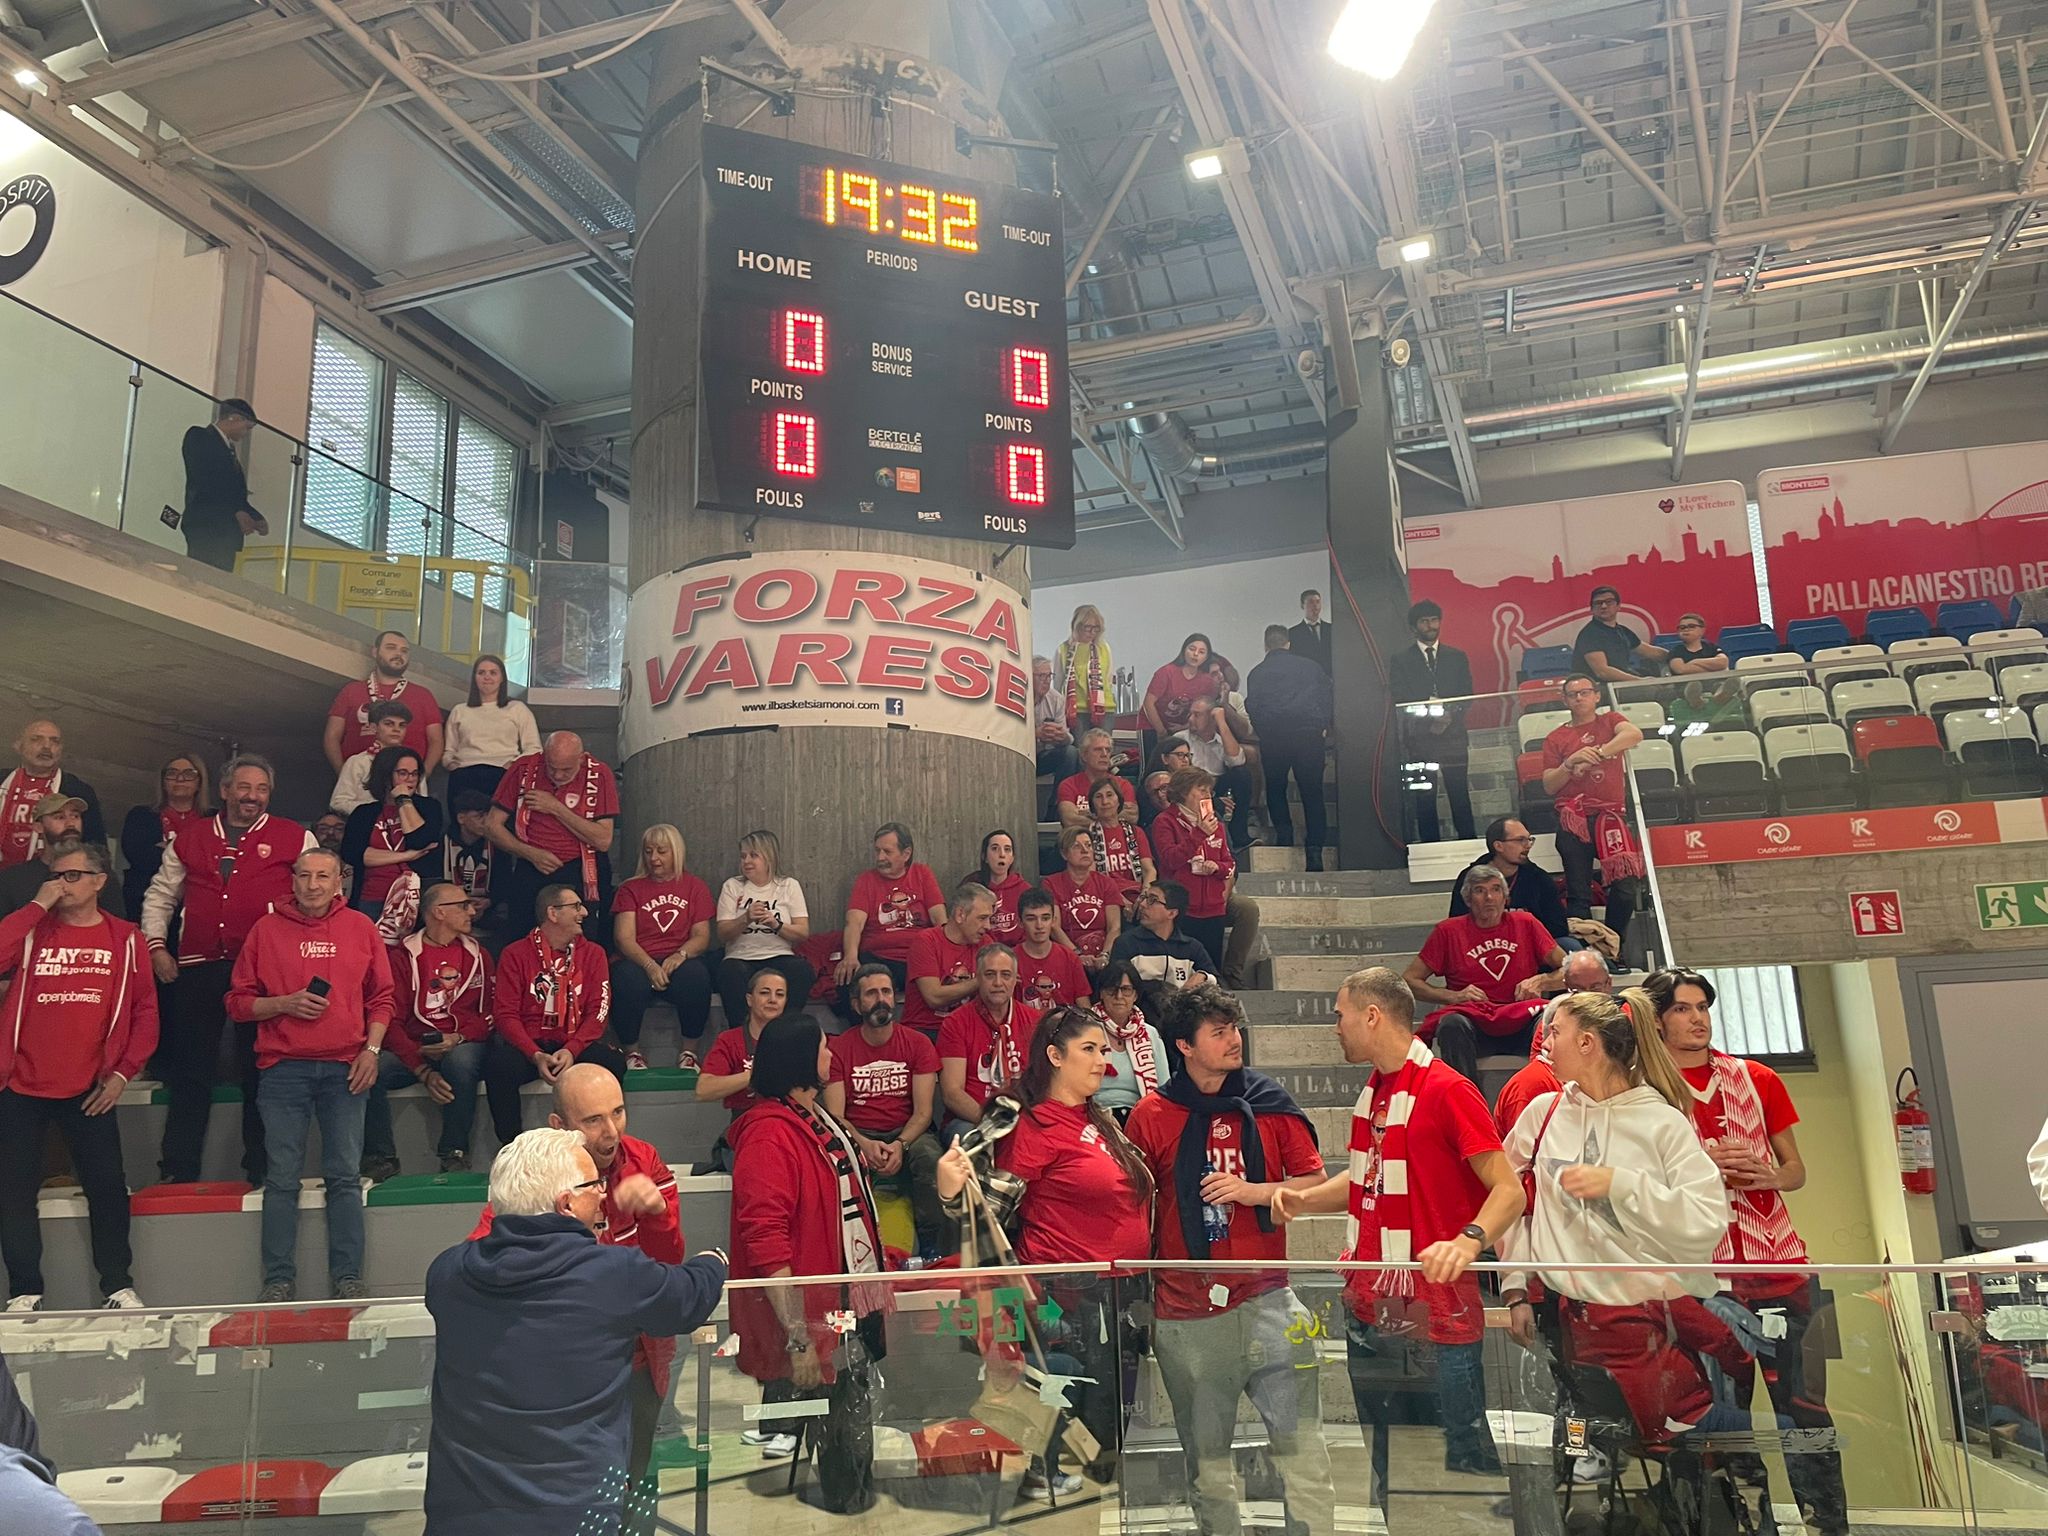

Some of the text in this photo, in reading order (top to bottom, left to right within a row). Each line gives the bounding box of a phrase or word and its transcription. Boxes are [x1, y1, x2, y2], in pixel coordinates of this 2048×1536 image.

[717, 167, 774, 192] TIME-OUT
[825, 168, 979, 252] 19:32
[1002, 225, 1052, 247] TIME-OUT
[738, 249, 812, 279] HOME
[866, 249, 918, 272] PERIODS
[964, 290, 1040, 319] GUEST
[785, 310, 824, 372] 0
[871, 342, 912, 363] BONUS
[871, 360, 912, 378] SERVICE
[1013, 348, 1049, 407] 0
[751, 378, 804, 400] POINTS
[985, 413, 1032, 434] POINTS
[775, 412, 815, 475] 0
[1008, 444, 1045, 503] 0
[1780, 478, 1829, 490] MONTEDIL
[756, 487, 804, 508] FOULS
[1680, 499, 1736, 513] My Kitchen
[1685, 494, 1708, 503] Love
[984, 514, 1028, 534] FOULS
[1404, 529, 1440, 538] ONTEDIL
[361, 567, 402, 578] Comune
[1806, 563, 2015, 614] PALLACANESTRO
[672, 568, 1020, 656] FORZA
[646, 633, 1029, 719] VARESE
[741, 699, 880, 712] www.ilbasketsiamonoi.com
[641, 894, 689, 913] VARESE
[1466, 938, 1519, 960] VARESE
[1297, 997, 1337, 1017] FIL
[852, 1075, 908, 1092] VARESE
